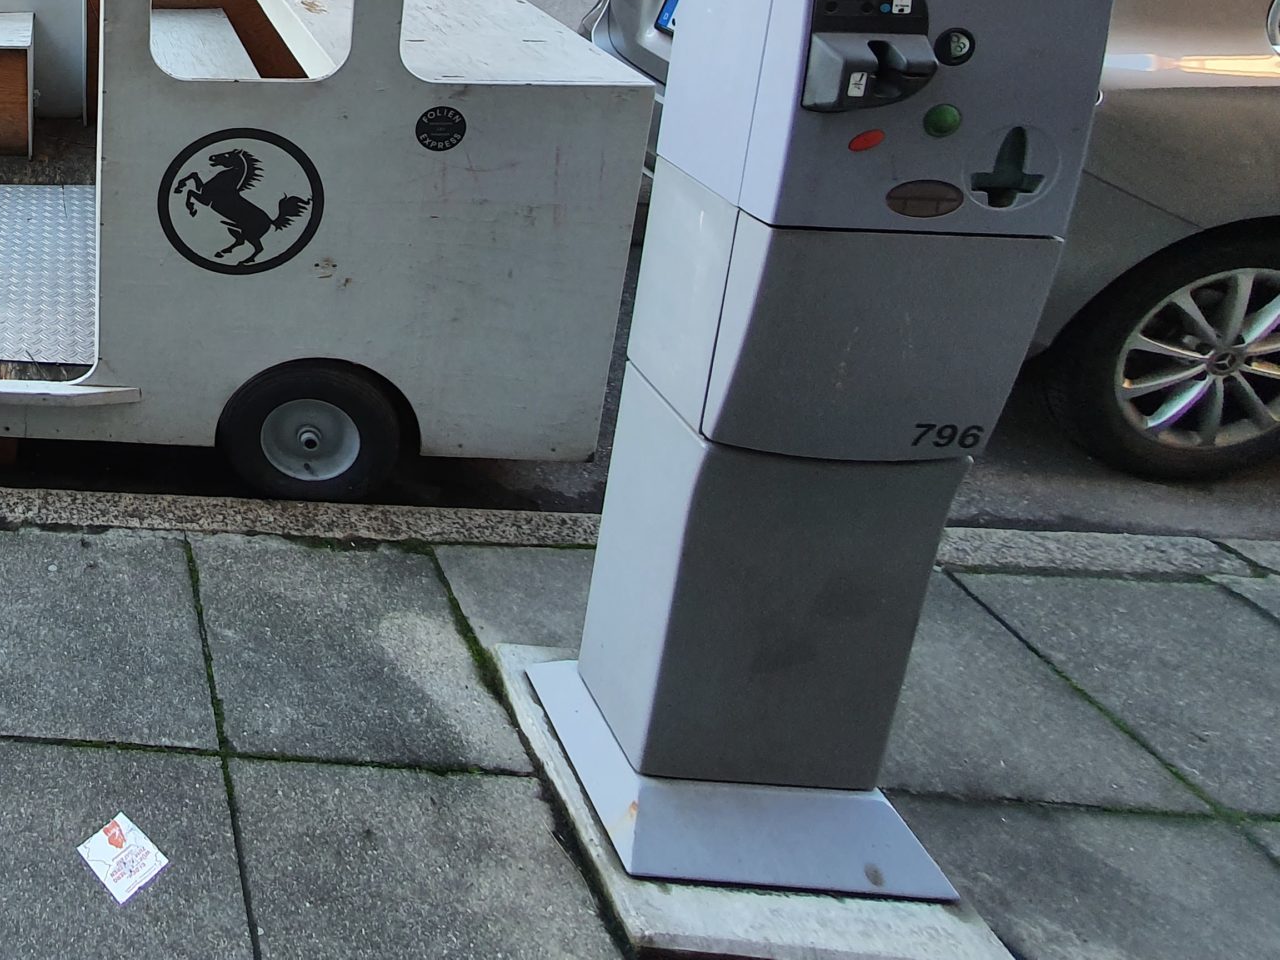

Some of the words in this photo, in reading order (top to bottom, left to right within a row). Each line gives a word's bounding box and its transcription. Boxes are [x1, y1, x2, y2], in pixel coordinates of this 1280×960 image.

[422, 108, 462, 124] FOLIEN
[419, 133, 462, 149] EXPRESS
[911, 423, 985, 449] 796
